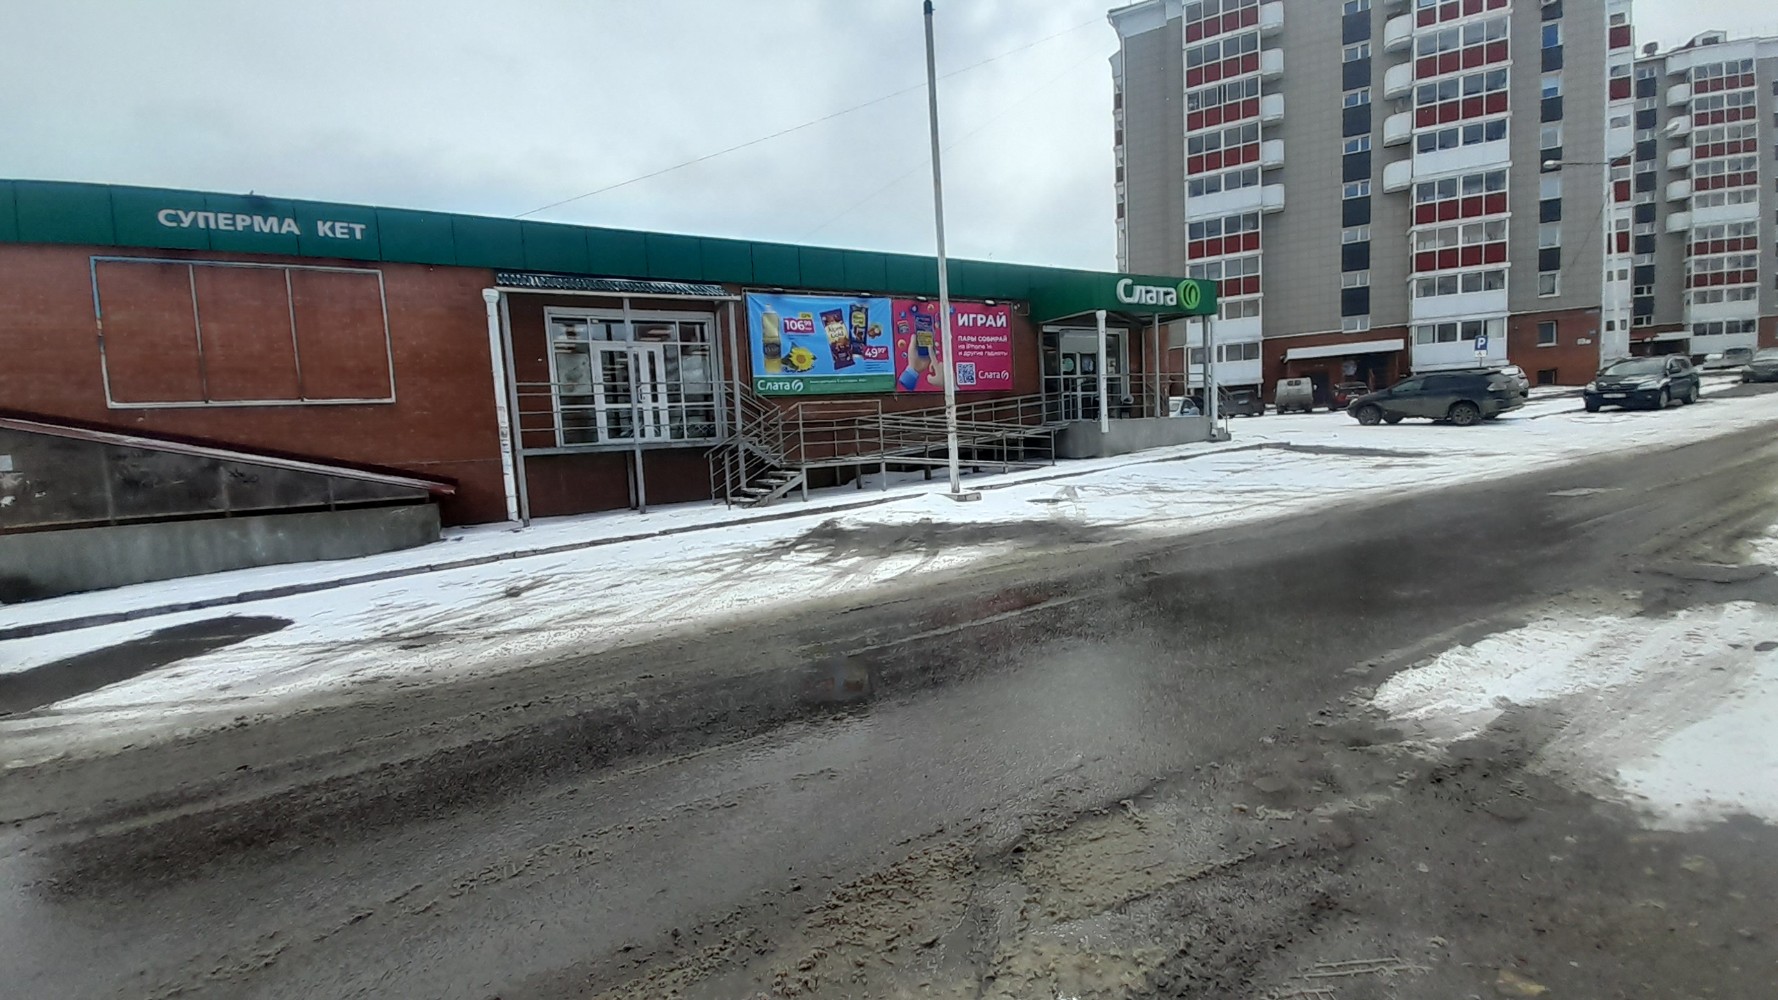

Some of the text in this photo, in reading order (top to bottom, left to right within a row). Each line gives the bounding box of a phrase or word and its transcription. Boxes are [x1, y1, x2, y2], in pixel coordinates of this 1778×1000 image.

[157, 209, 367, 240] СУПЕРМА КЕТ
[1116, 278, 1177, 306] Слата
[957, 312, 1006, 328] ИГРАЙ
[1478, 338, 1486, 351] P
[978, 370, 1001, 380] Слата
[757, 380, 791, 391] Слата
